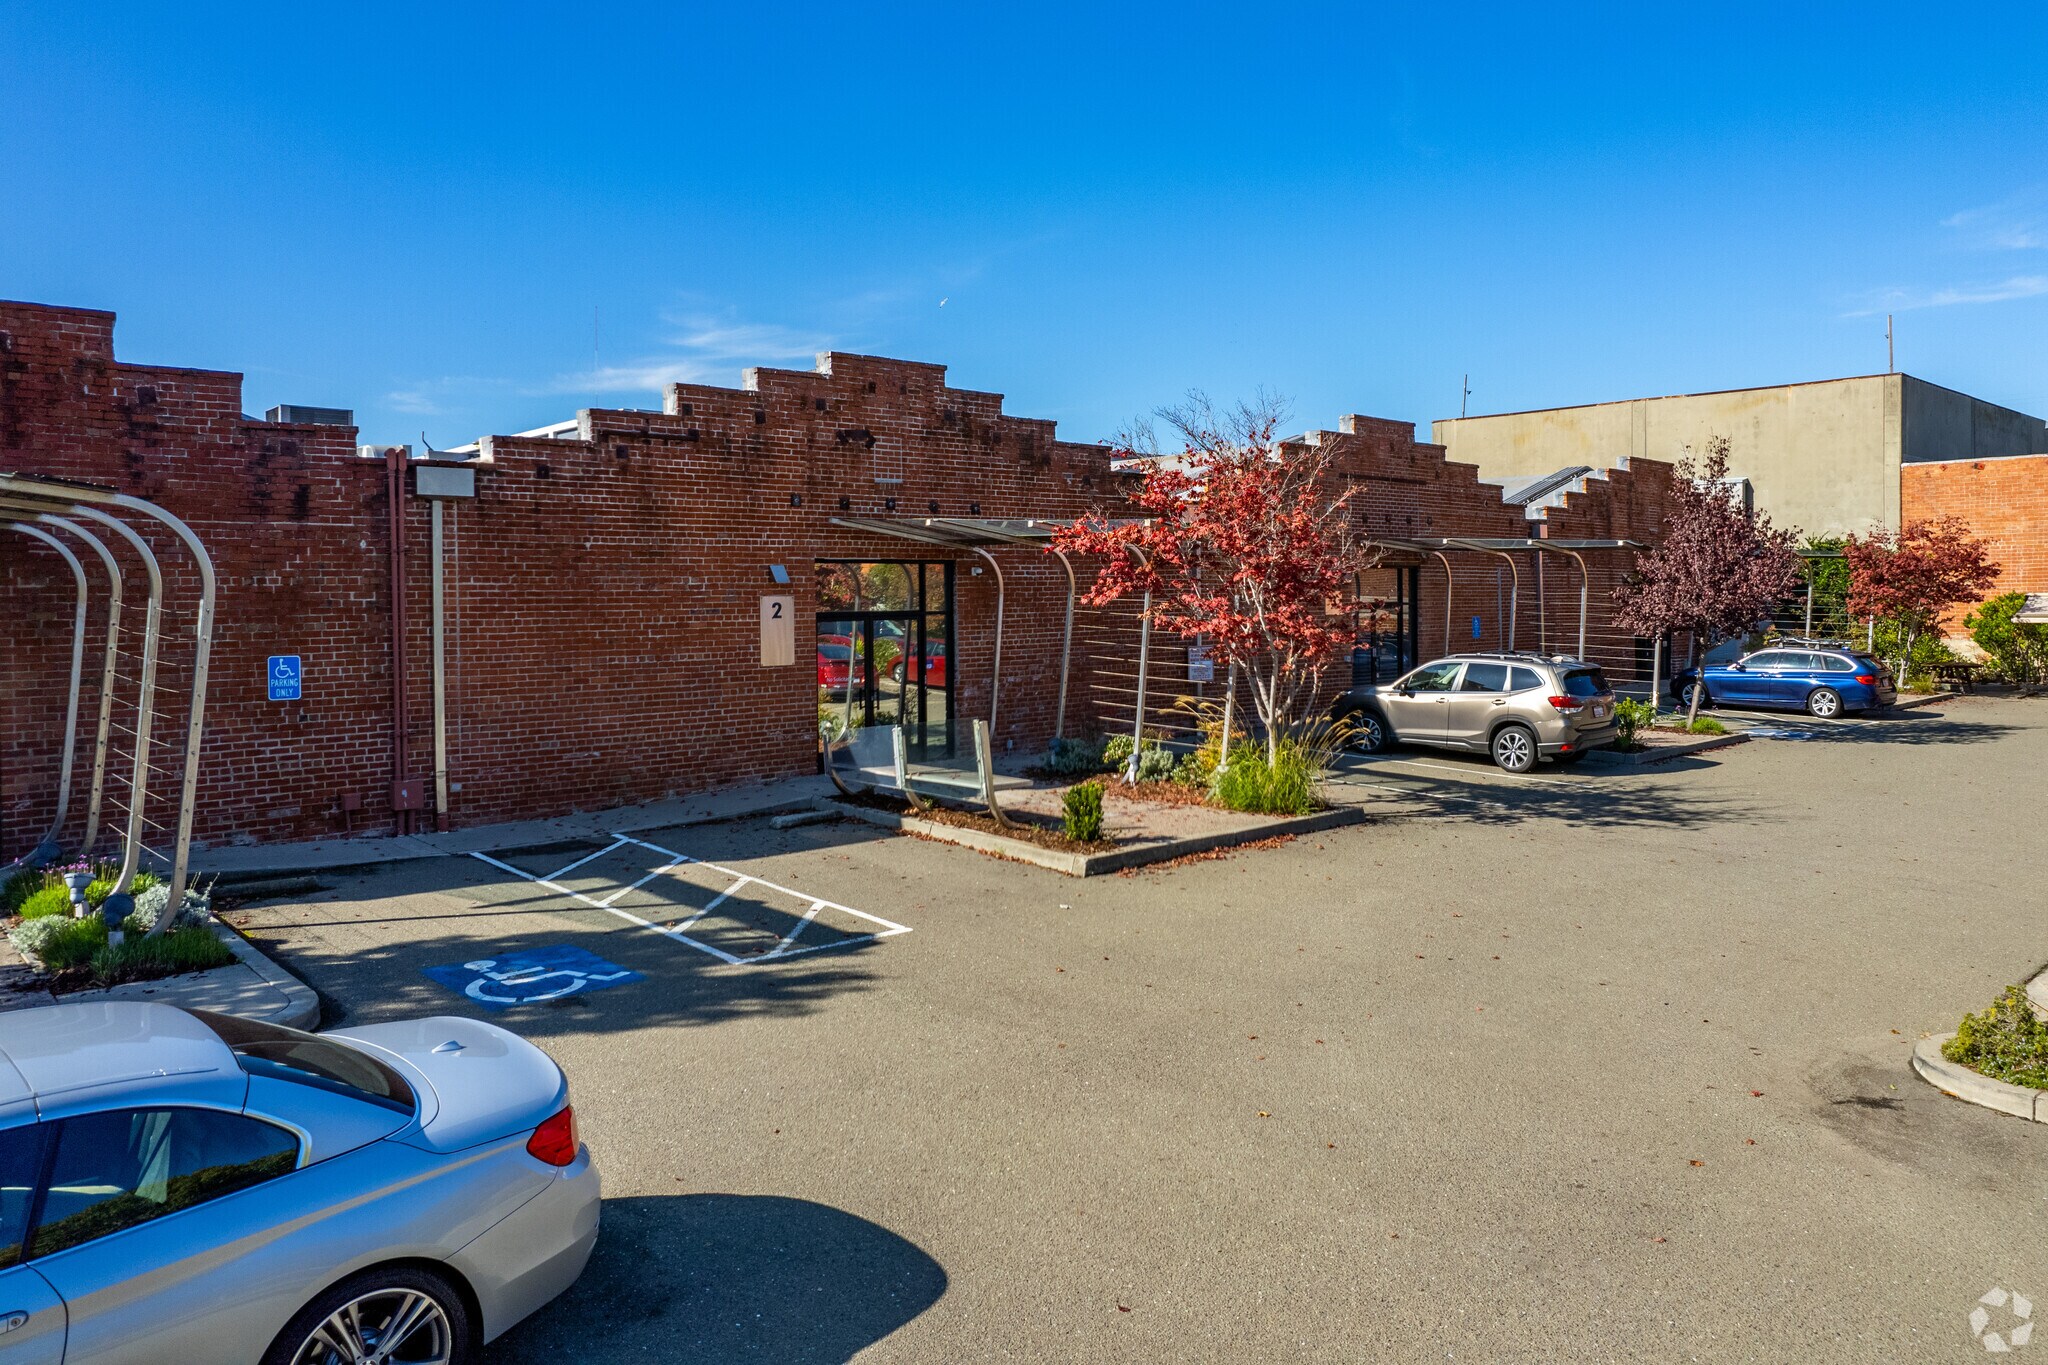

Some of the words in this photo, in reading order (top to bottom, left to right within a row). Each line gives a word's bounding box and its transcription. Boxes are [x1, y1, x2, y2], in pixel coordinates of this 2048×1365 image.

[772, 602, 782, 619] 2
[271, 678, 298, 687] PARKING
[276, 688, 293, 697] ONLY
